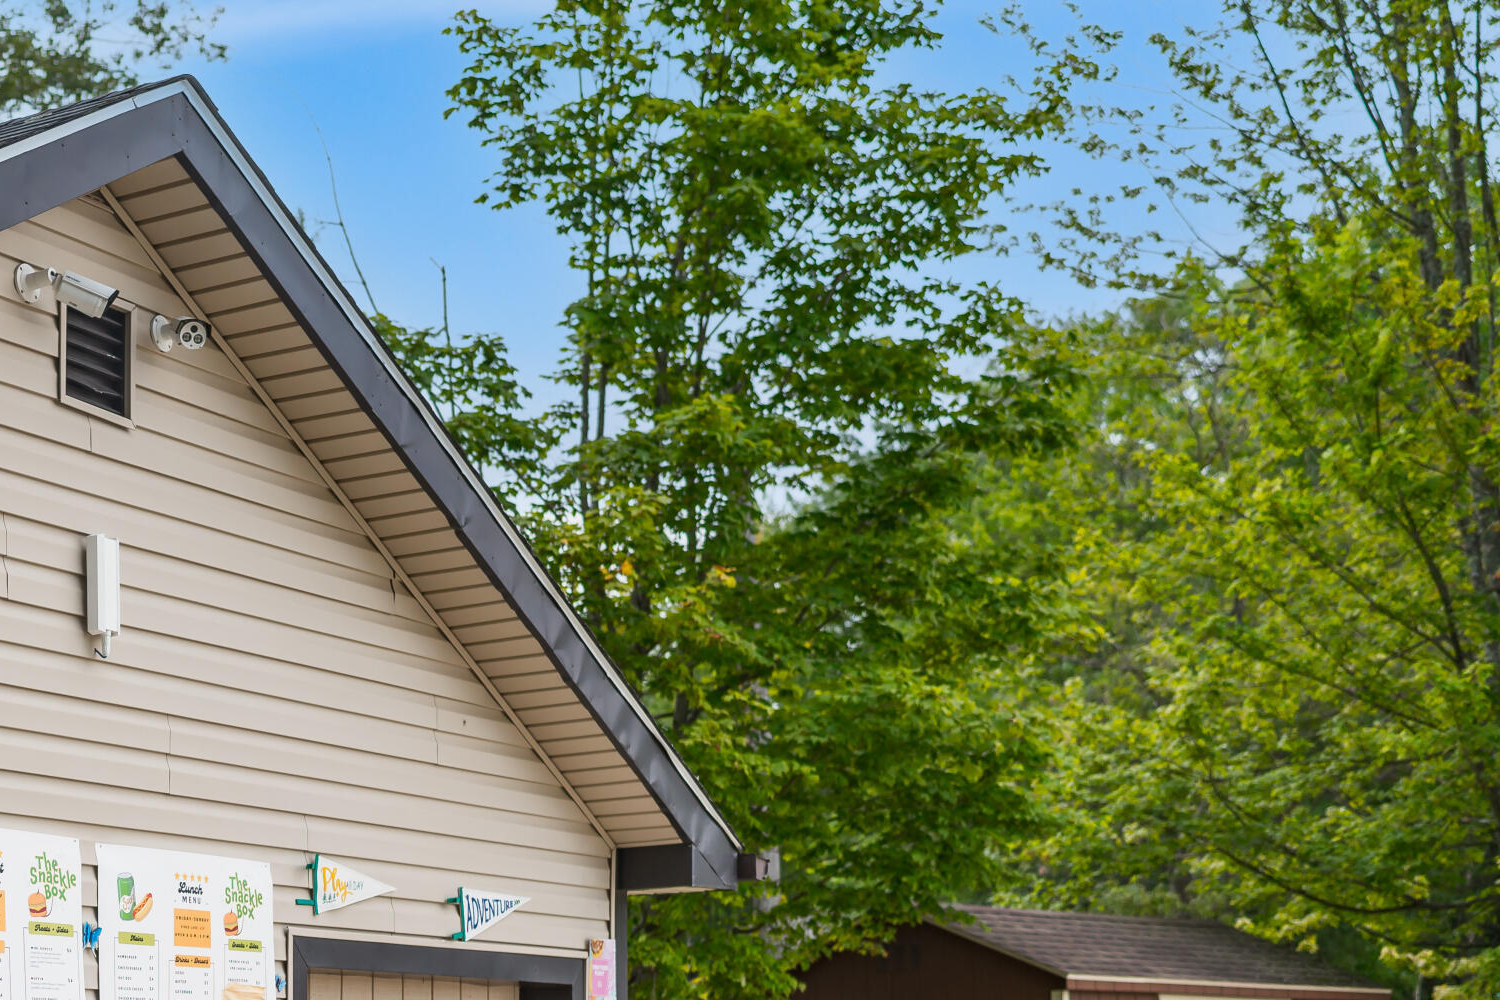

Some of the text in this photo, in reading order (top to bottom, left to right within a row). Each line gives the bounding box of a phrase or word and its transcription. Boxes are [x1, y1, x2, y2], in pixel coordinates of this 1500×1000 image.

[35, 851, 58, 872] The
[30, 866, 76, 889] Snackle
[229, 872, 248, 891] The
[321, 866, 350, 904] Play
[44, 884, 67, 902] Box
[178, 882, 203, 895] Lunch
[225, 887, 263, 908] Snackle
[182, 896, 201, 904] MENU
[236, 903, 255, 920] Box
[465, 894, 513, 933] ADVENTURE
